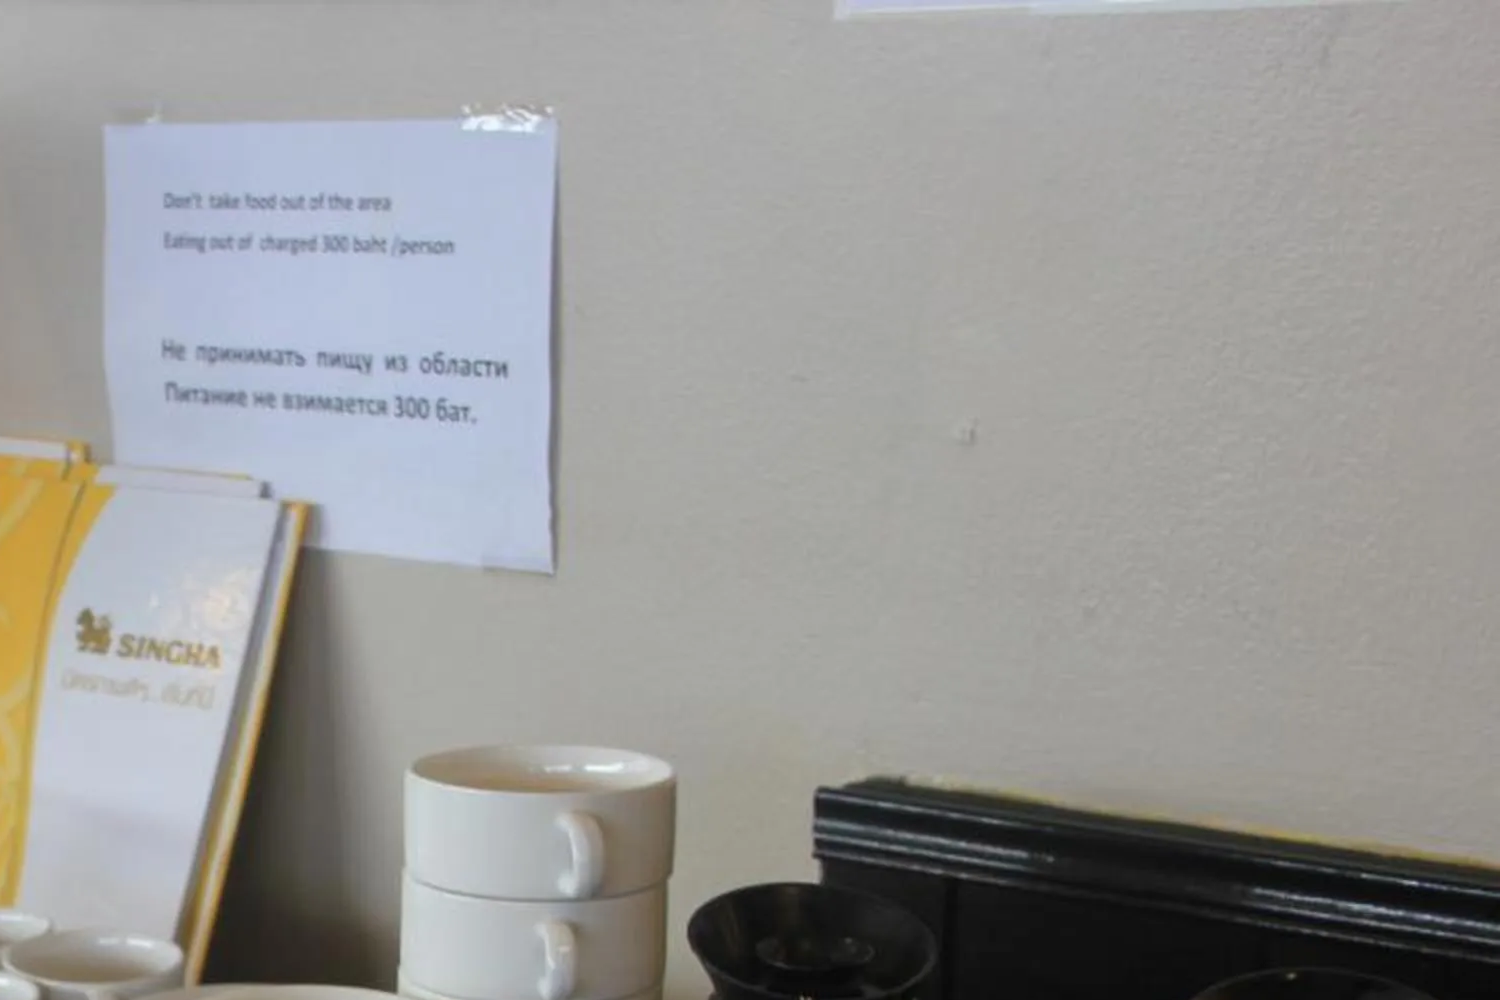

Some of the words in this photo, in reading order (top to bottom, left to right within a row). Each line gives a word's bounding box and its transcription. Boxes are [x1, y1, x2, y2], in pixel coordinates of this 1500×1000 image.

[163, 191, 203, 210] Don't
[209, 191, 240, 210] take
[244, 191, 277, 210] food
[280, 194, 305, 211] out
[309, 192, 325, 211] of
[328, 193, 353, 211] the
[357, 196, 392, 212] area
[163, 231, 206, 255] Eating
[209, 234, 234, 250] out
[238, 231, 254, 251] of
[259, 233, 318, 257] charged
[322, 235, 349, 253] 300
[353, 235, 388, 254] baht
[161, 338, 187, 362] Не
[196, 344, 307, 368] принимать
[316, 351, 374, 376] пищу
[385, 355, 409, 373] из
[419, 350, 509, 379] области
[164, 380, 249, 409] Питание
[252, 390, 278, 410] не
[282, 391, 389, 417] взимается
[393, 394, 431, 420] 300
[436, 396, 479, 425] бат.
[117, 633, 222, 669] SINGHA
